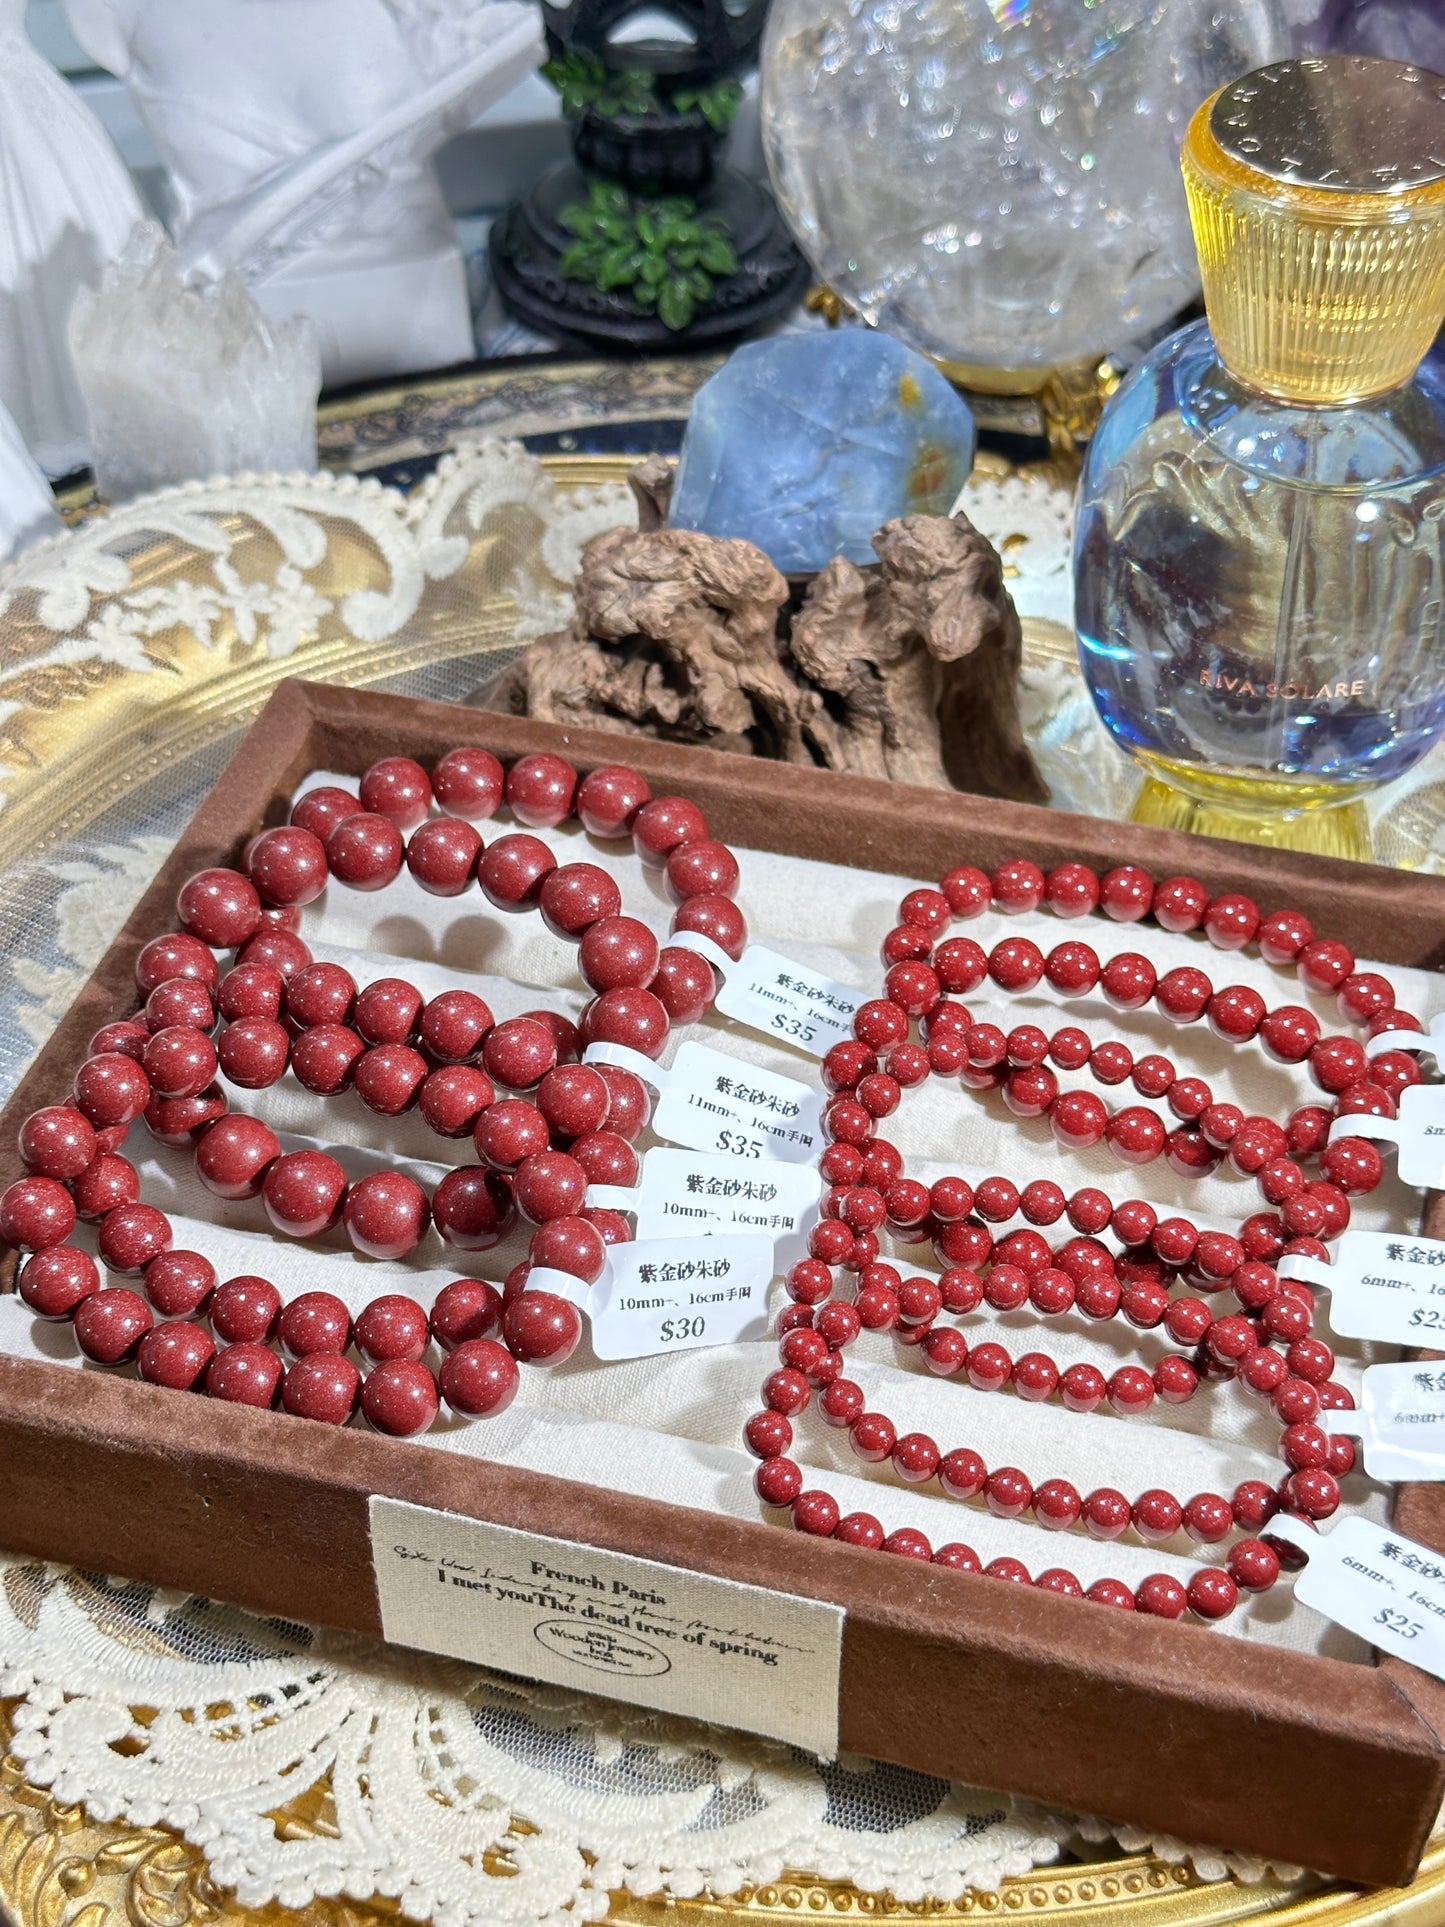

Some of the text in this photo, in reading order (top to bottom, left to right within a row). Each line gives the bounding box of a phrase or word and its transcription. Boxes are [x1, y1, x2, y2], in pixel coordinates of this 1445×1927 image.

[1200, 669, 1365, 699] RIVA SOLARE
[775, 973, 855, 1018] 紫金砂朱砂
[771, 1014, 818, 1042] $35
[715, 1076, 800, 1118] 紫金砂朱砂
[716, 1129, 763, 1159] $35
[686, 1174, 777, 1202] 紫金砂朱砂
[638, 1258, 731, 1284] 紫金砂朱砂
[660, 1316, 705, 1342] $30
[531, 1560, 605, 1591] French
[612, 1580, 667, 1605] Paris
[438, 1568, 446, 1582] I
[452, 1576, 492, 1594] met
[581, 1604, 630, 1629] dead
[636, 1621, 678, 1639] tree
[682, 1631, 706, 1646] of
[709, 1642, 779, 1666] spring
[1373, 1608, 1424, 1639] $25
